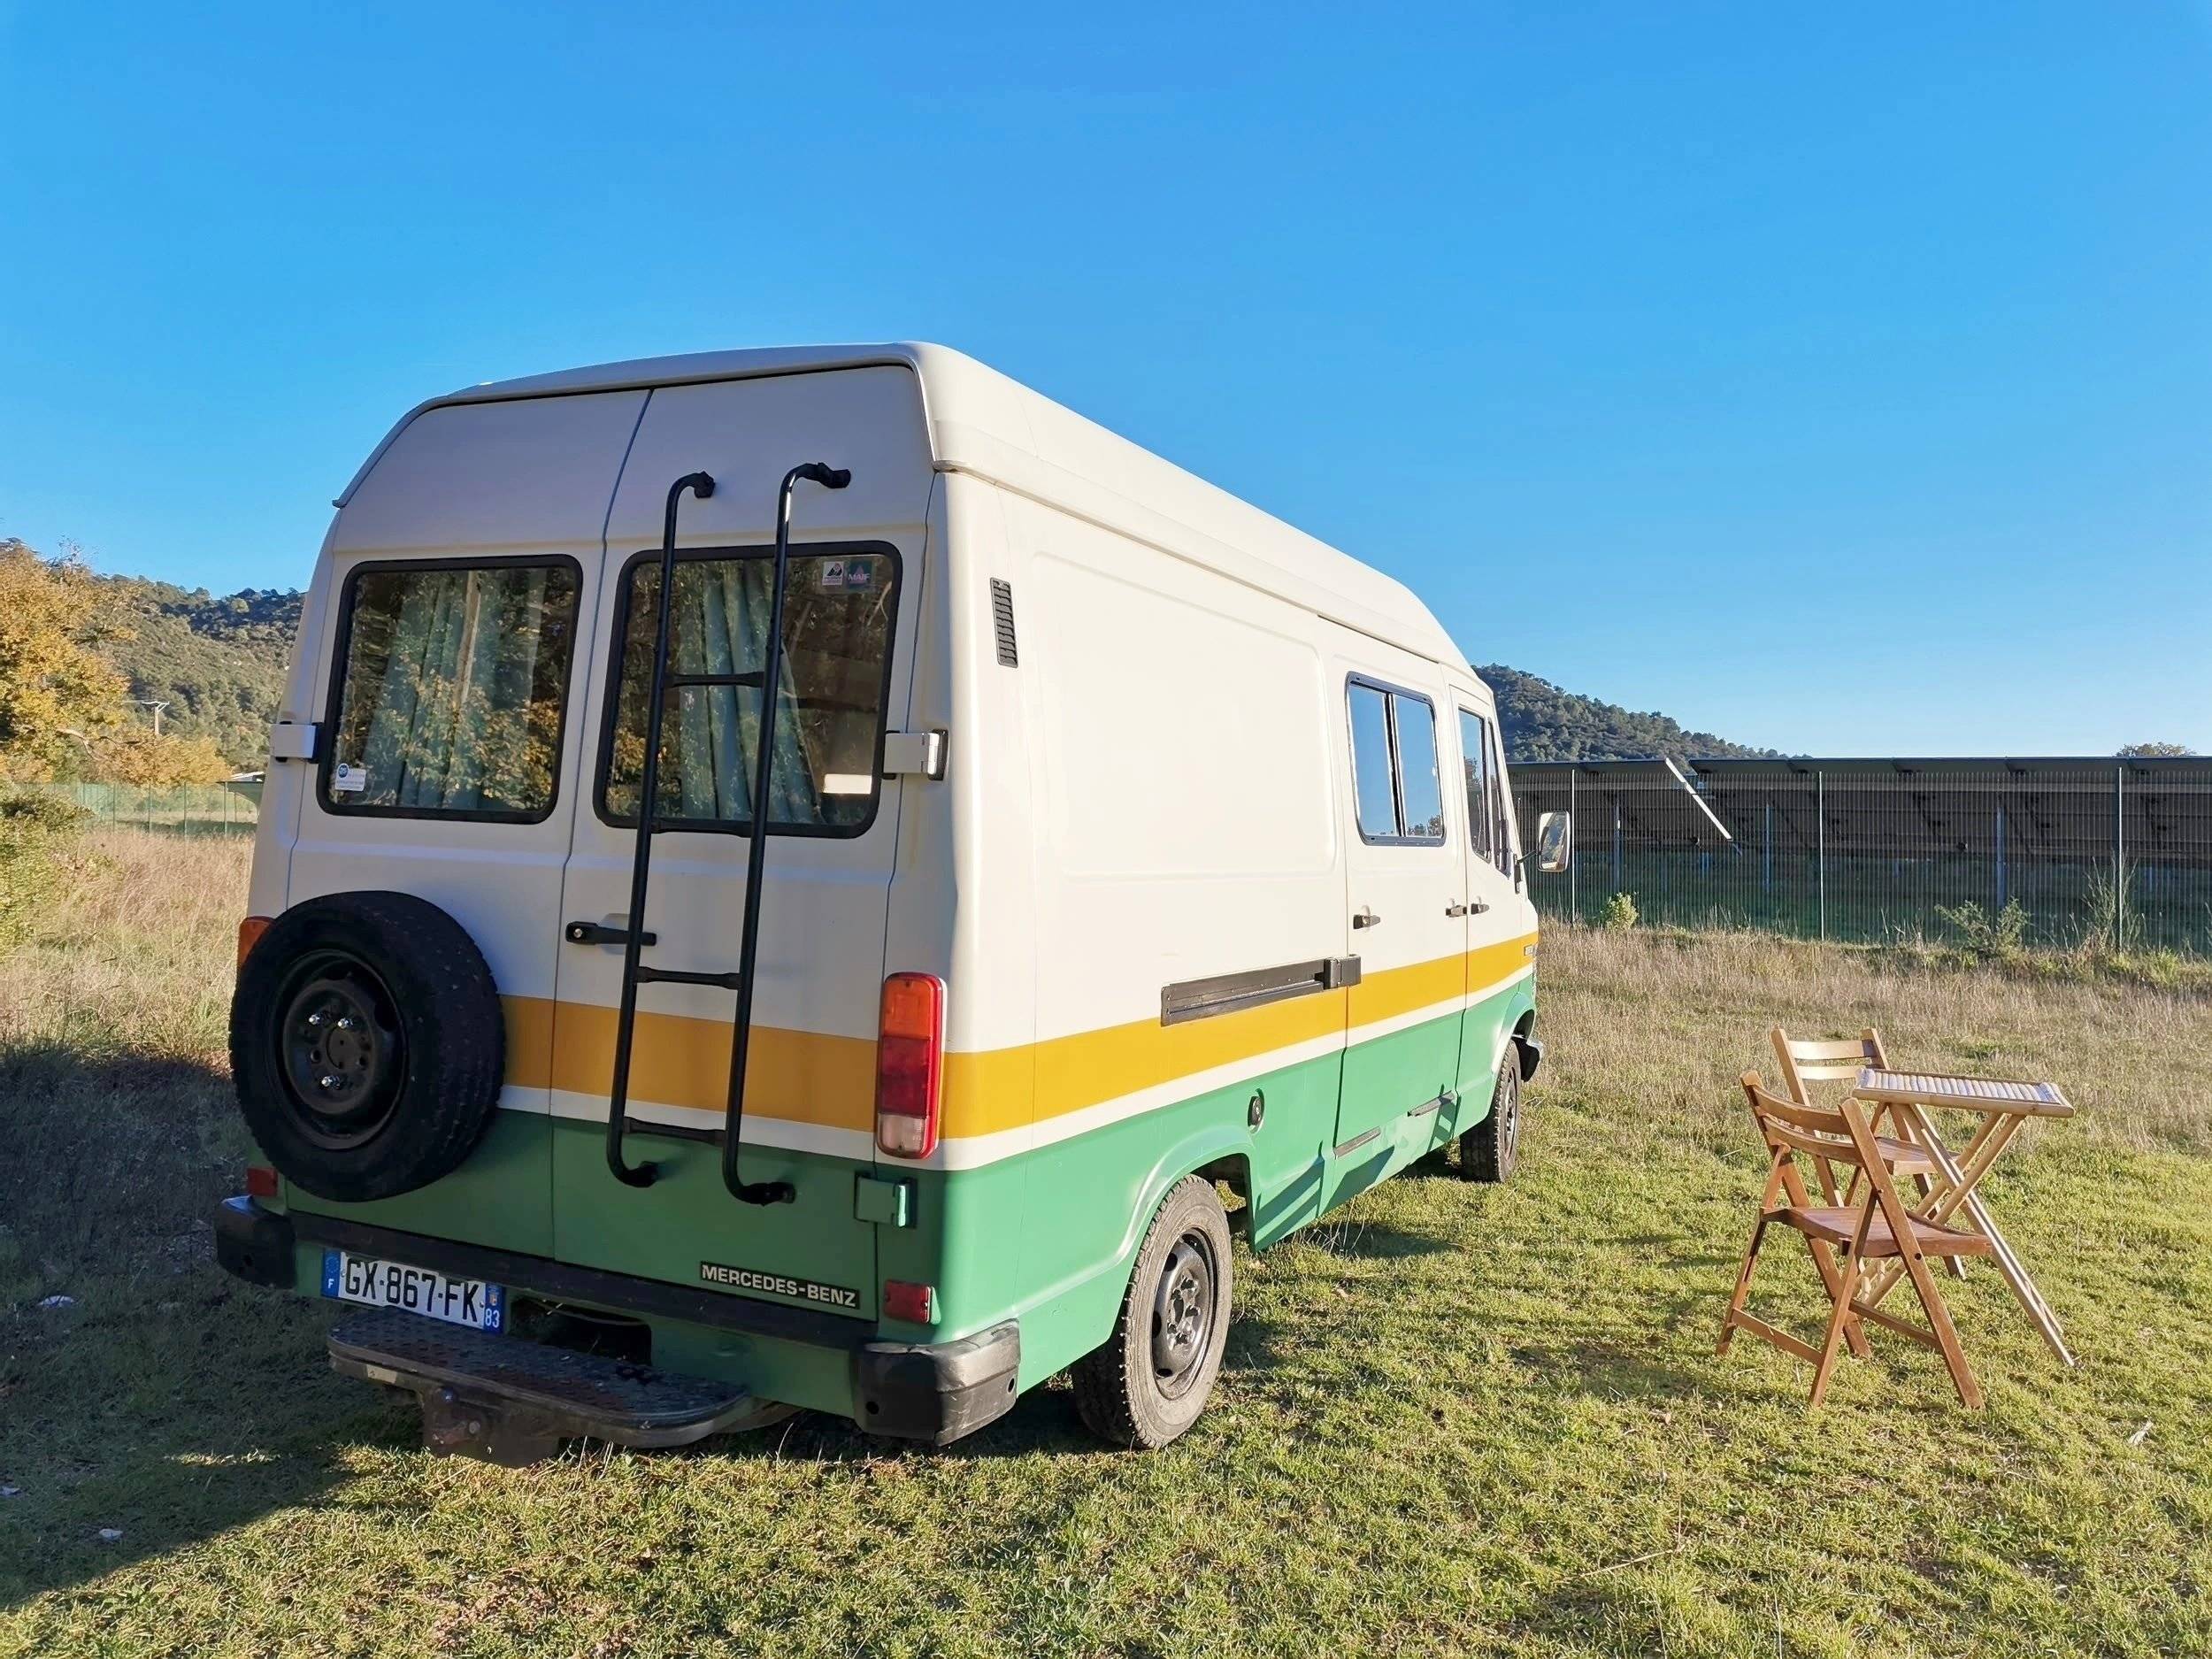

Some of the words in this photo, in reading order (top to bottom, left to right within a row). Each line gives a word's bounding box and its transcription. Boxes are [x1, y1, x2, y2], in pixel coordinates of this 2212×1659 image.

[327, 1278, 334, 1289] F
[345, 1257, 480, 1323] GX-867-FK
[702, 1263, 856, 1308] MERCEDES-BENZ
[485, 1308, 500, 1328] 83
